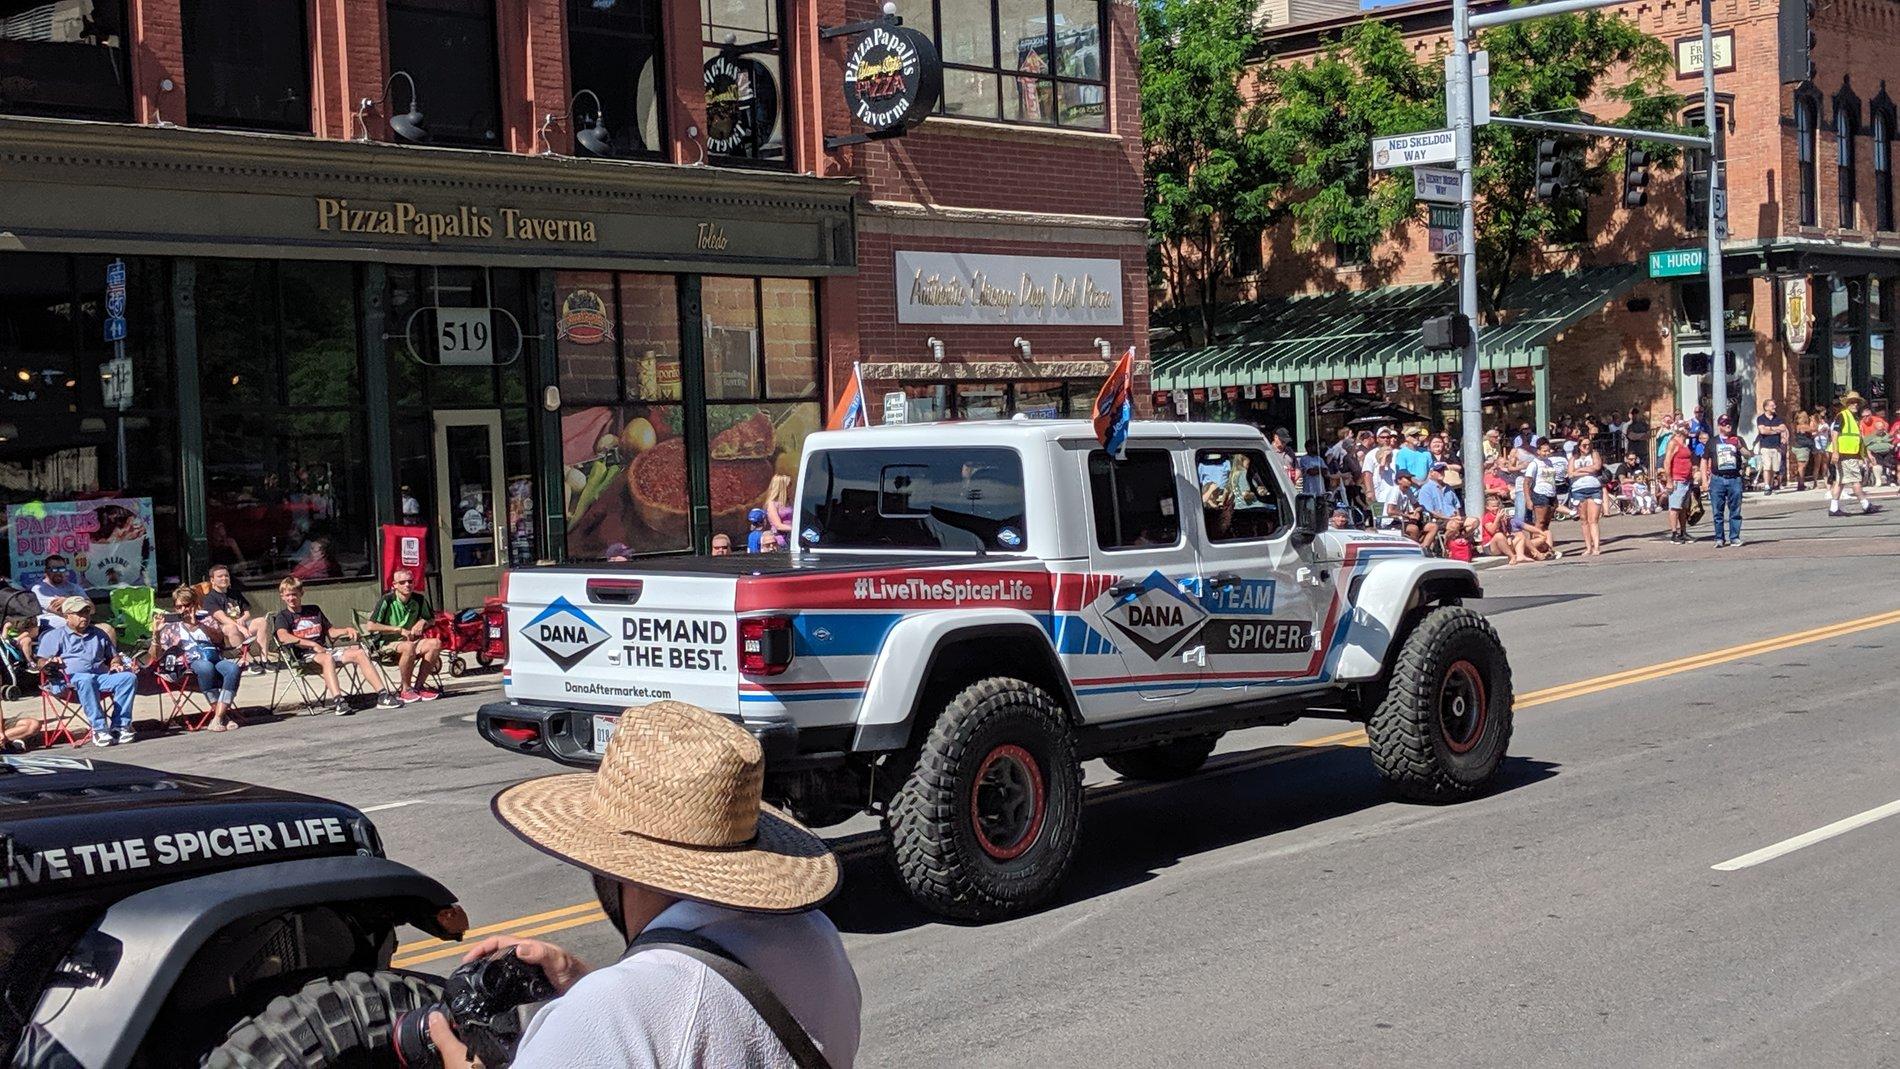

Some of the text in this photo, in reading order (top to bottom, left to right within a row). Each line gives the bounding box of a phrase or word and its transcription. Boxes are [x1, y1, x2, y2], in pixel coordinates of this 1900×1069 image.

[844, 27, 917, 82] PizzaPapalis
[856, 97, 910, 126] Taverna
[1389, 133, 1452, 151] NED SKELDON
[1404, 150, 1427, 161] WAY
[316, 197, 597, 242] PizzaPapalis Taverna
[697, 222, 728, 250] Toledo
[1652, 252, 1706, 269] N. HURON
[442, 321, 489, 351] 519
[16, 512, 100, 535] PAPALIS
[17, 532, 90, 556] PUNCH
[97, 556, 129, 570] MALIBU
[854, 577, 1033, 605] #LiveTheSpicerLife
[1217, 585, 1271, 610] TEAM
[1128, 605, 1185, 627] DANA
[540, 624, 589, 644] DANA
[622, 617, 728, 644] DEMAND
[1228, 624, 1301, 649] SPICER
[623, 645, 728, 671] THE BEST.
[564, 682, 672, 699] DanaAftermarket.com
[71, 838, 150, 876] THE
[153, 823, 274, 866] SPICER
[277, 817, 347, 848] LIFE
